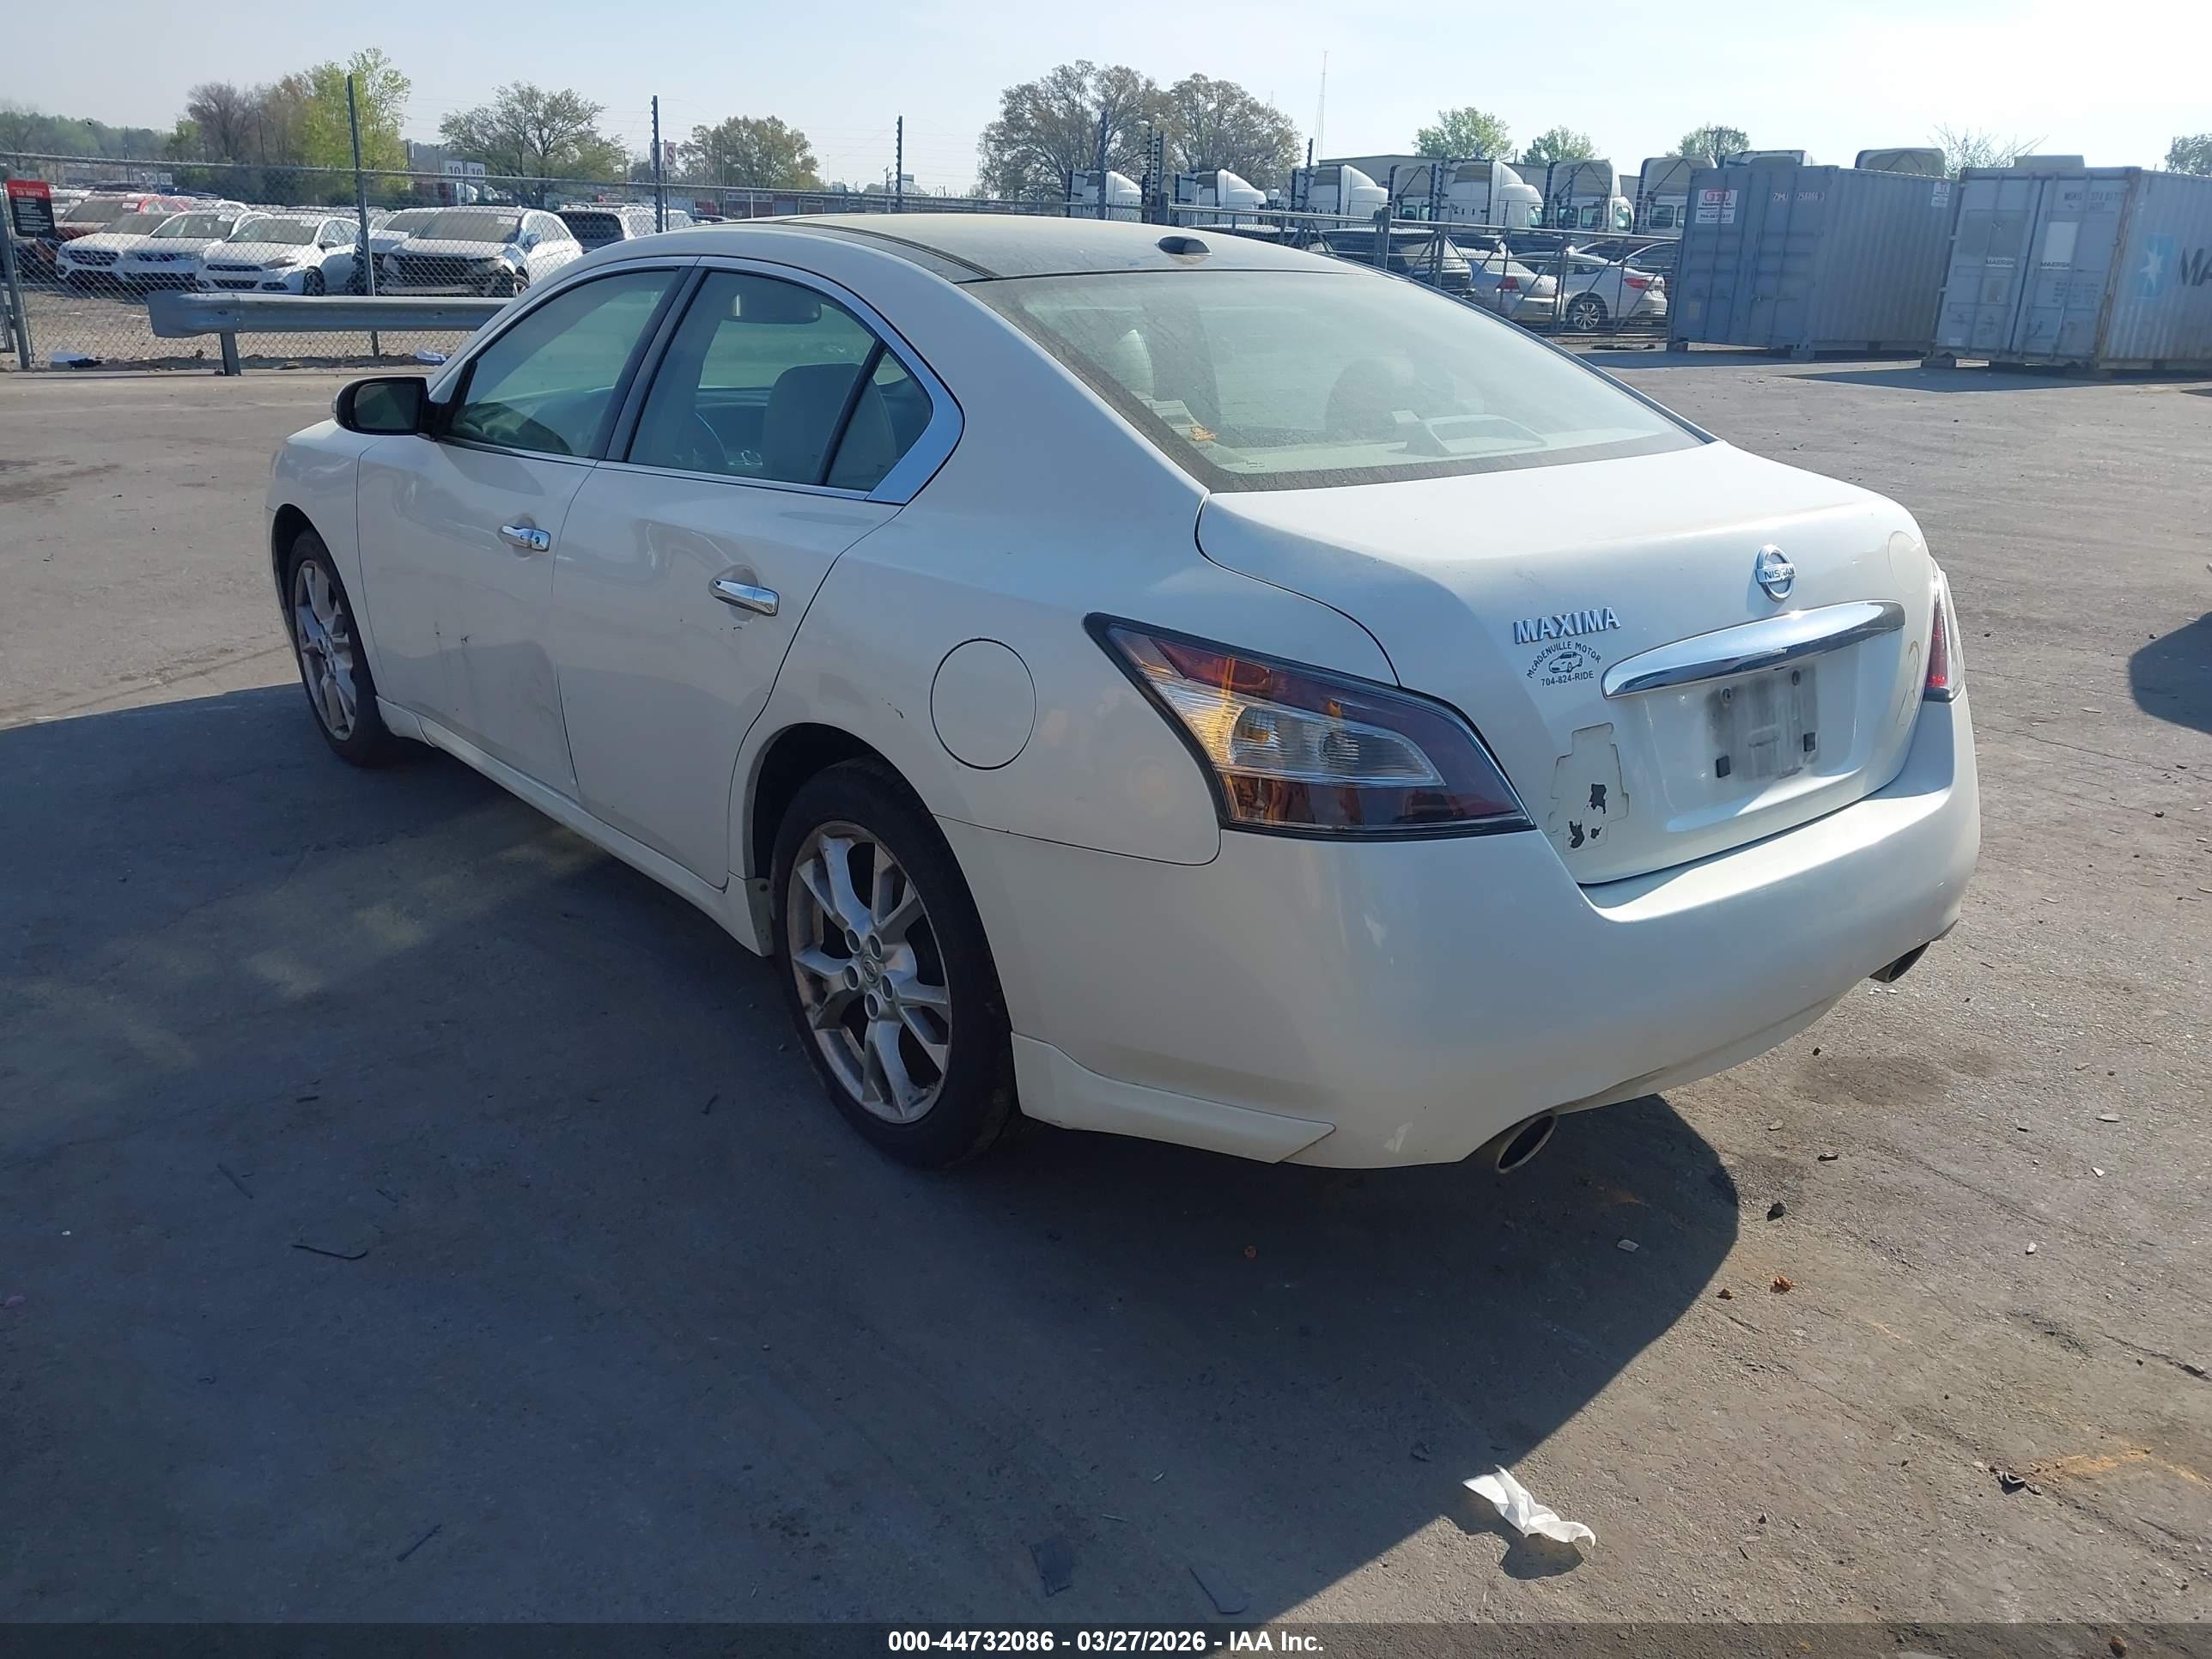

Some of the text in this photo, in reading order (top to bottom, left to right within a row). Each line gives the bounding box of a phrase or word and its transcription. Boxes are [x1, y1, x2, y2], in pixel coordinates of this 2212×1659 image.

[1513, 607, 1621, 644] MAXIMA
[1574, 641, 1601, 665] MOTOR
[1540, 670, 1595, 687] 704-824-RIDE
